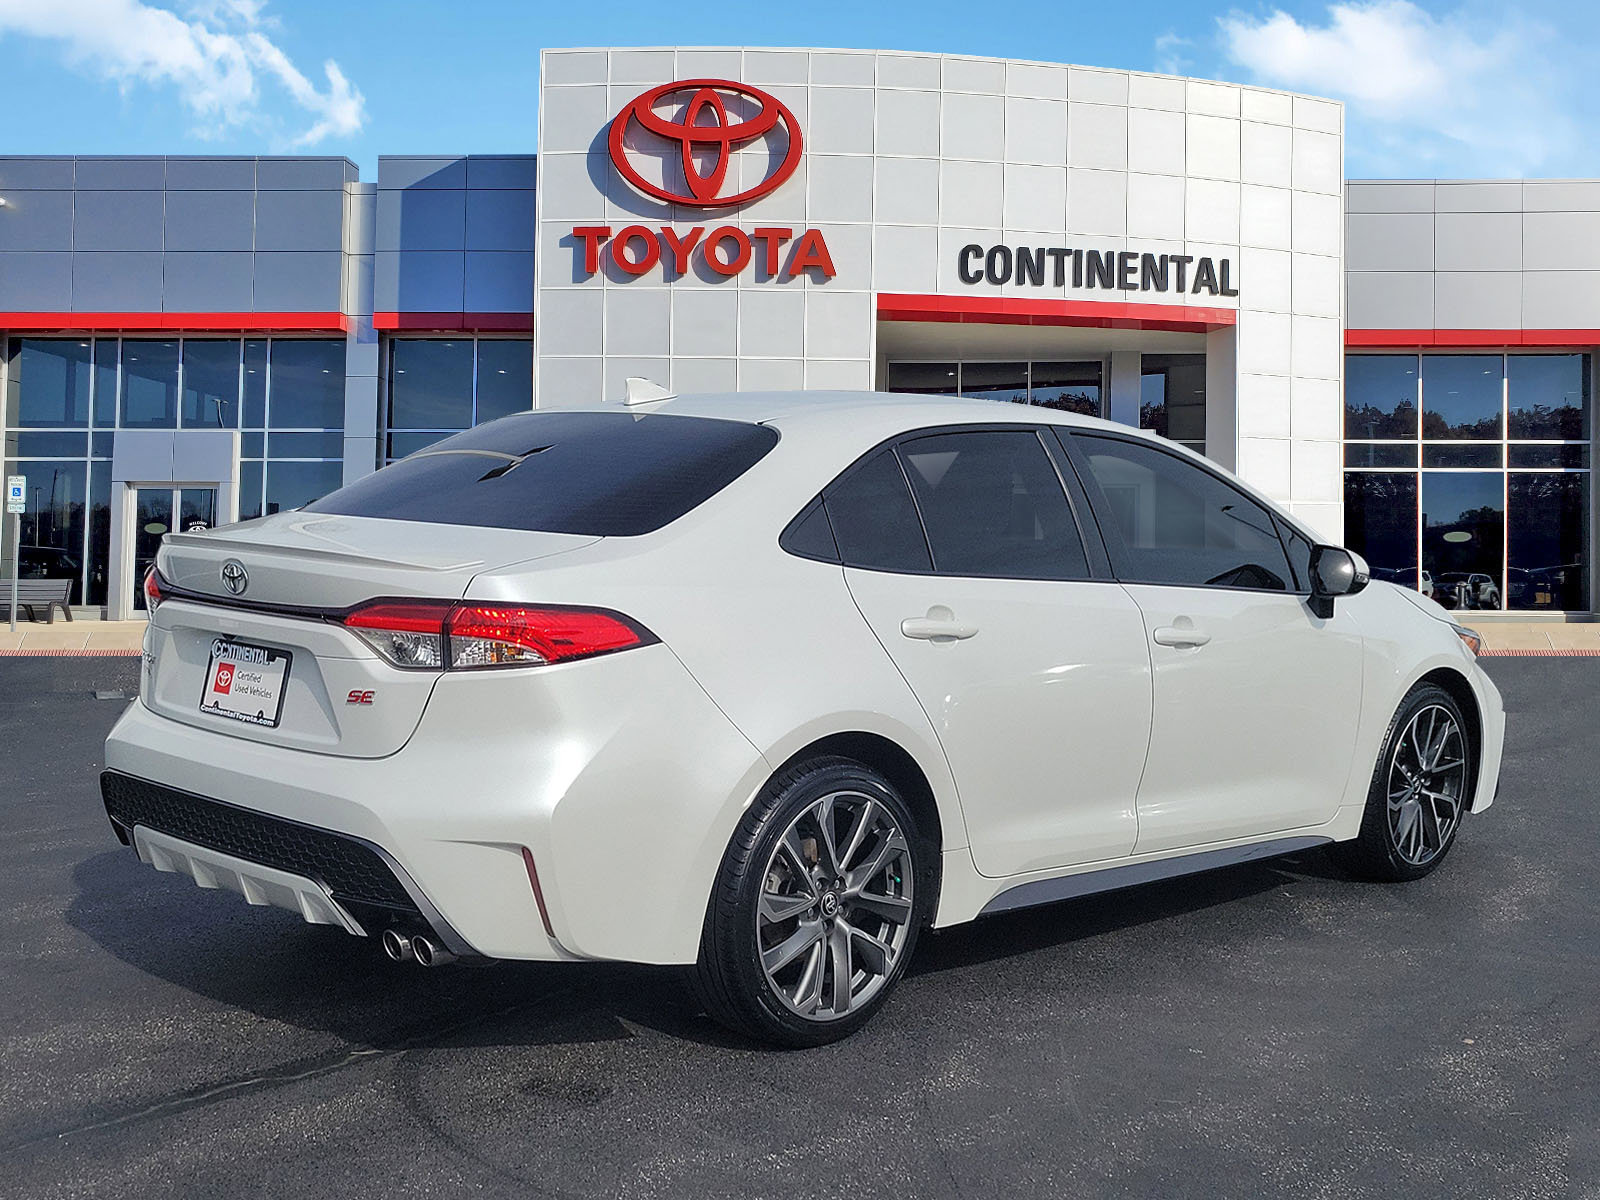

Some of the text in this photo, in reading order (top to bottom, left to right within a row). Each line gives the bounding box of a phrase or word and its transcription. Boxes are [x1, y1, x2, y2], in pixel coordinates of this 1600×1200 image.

[573, 225, 837, 277] TOYOTA
[958, 244, 1239, 297] CONTINENTAL
[237, 671, 262, 683] Certified
[234, 683, 272, 699] Used Vehicles
[346, 689, 376, 704] SE
